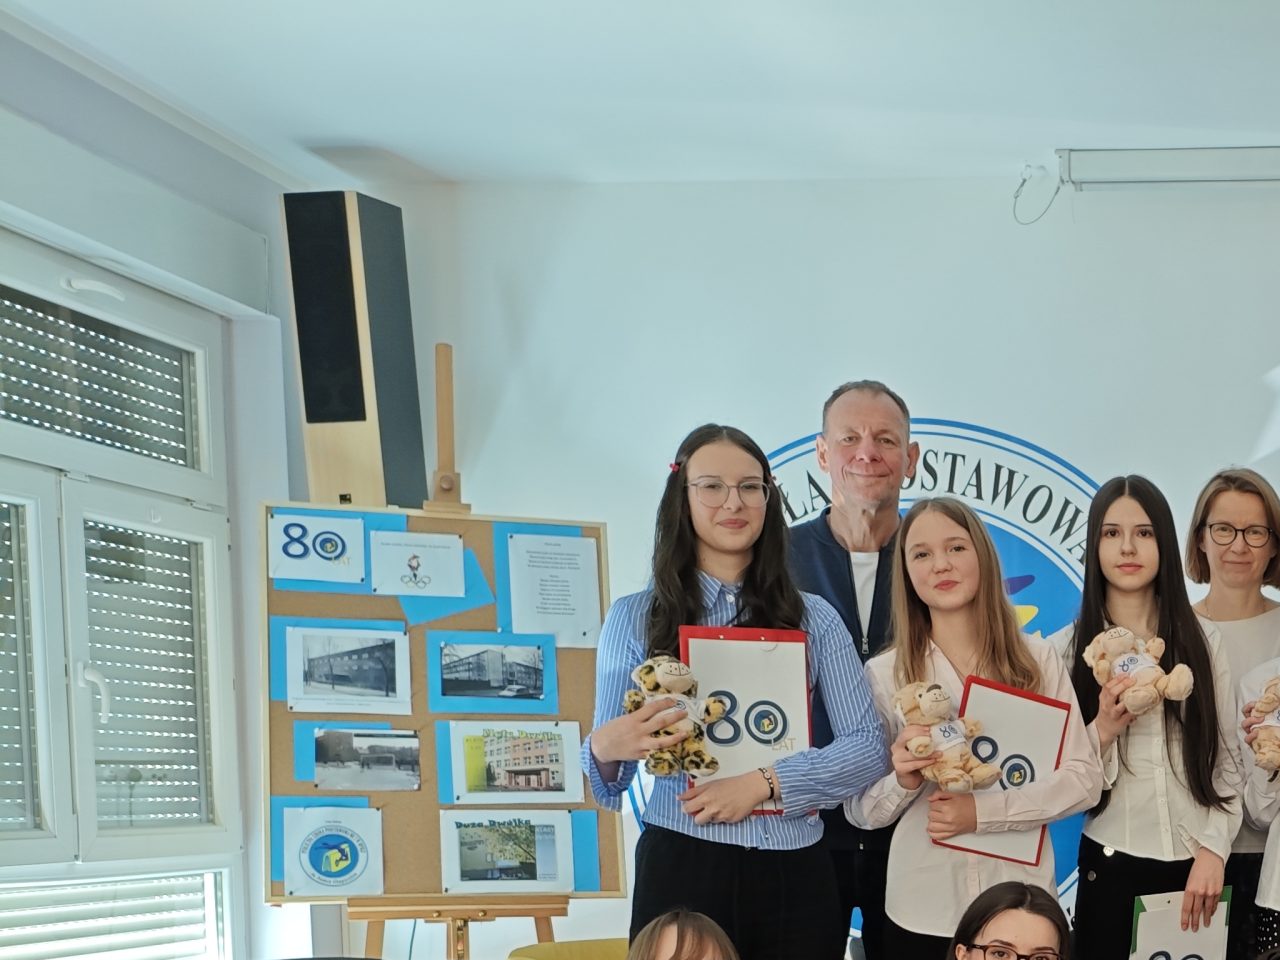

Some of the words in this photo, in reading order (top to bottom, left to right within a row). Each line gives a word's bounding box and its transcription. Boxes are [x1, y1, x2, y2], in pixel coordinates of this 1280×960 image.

[282, 522, 347, 561] 80
[1117, 656, 1139, 673] 80
[706, 690, 788, 746] 80
[771, 737, 797, 751] LAT
